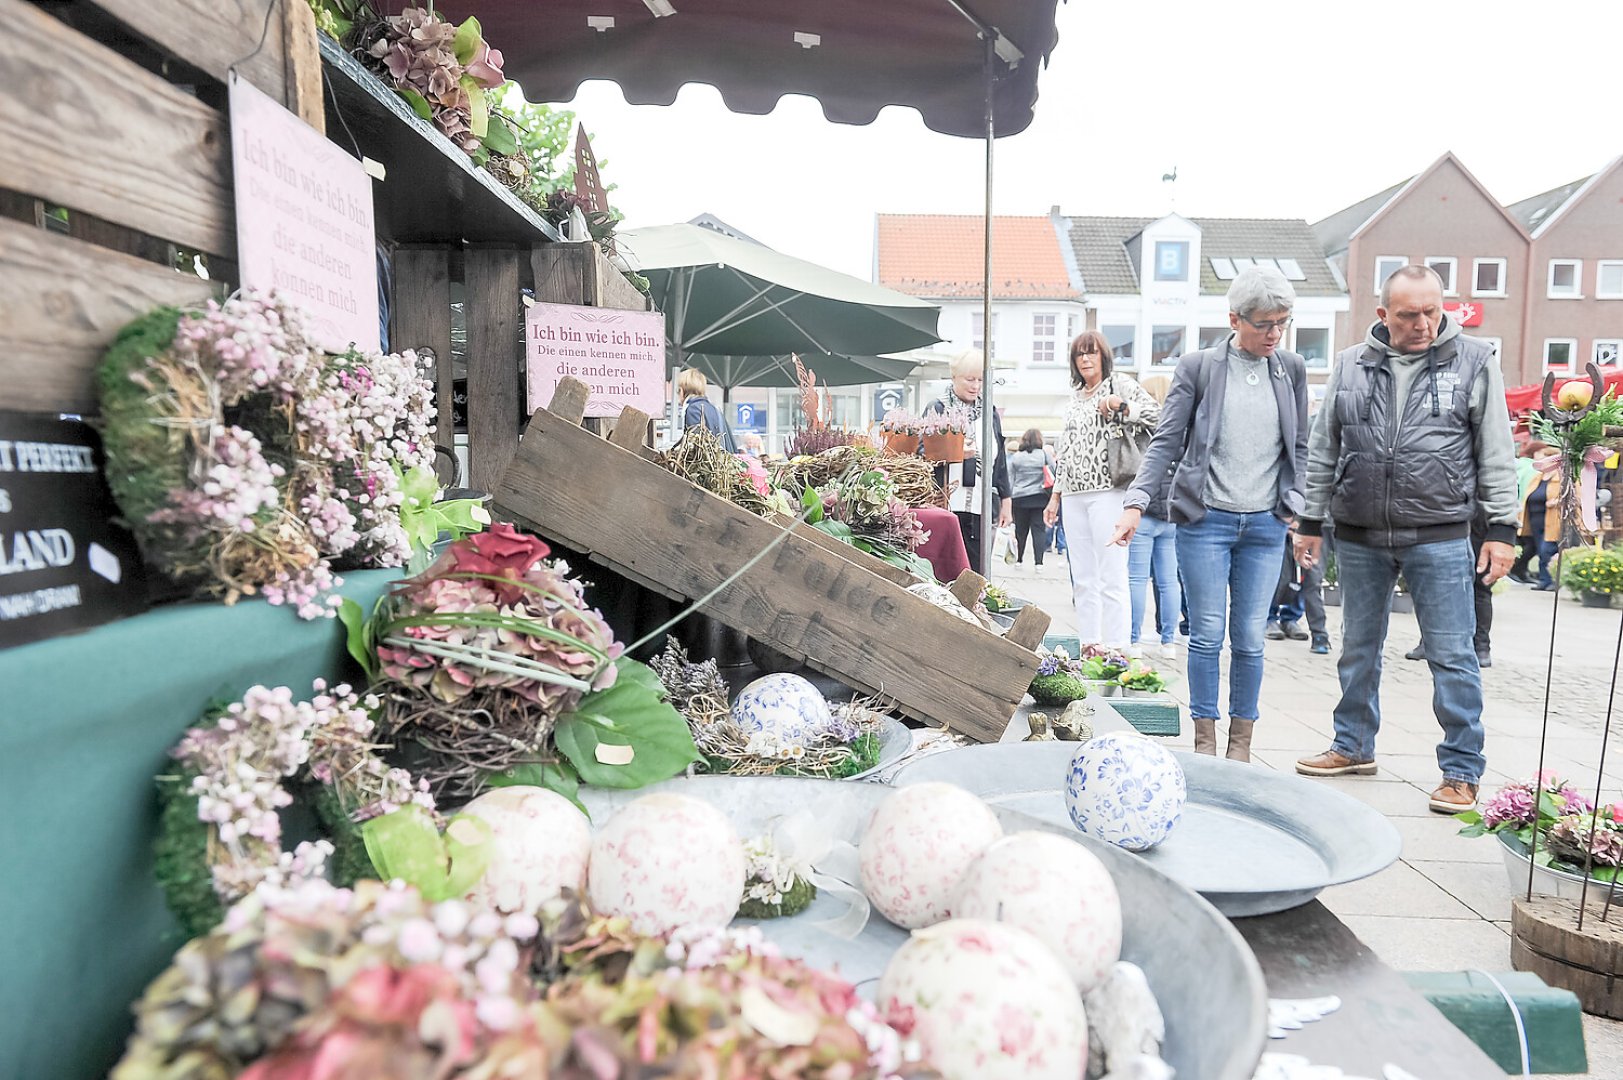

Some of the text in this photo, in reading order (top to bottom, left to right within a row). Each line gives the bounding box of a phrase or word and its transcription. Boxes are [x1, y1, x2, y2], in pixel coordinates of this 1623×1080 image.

[243, 129, 370, 229] Ich bin wie ich bin.
[273, 223, 352, 280] die anderen
[328, 286, 358, 315] mich
[533, 324, 660, 347] Ich bin wie ich bin.
[538, 345, 657, 363] Die einen kennen mich,
[556, 362, 635, 378] die anderen
[608, 383, 640, 396] mich
